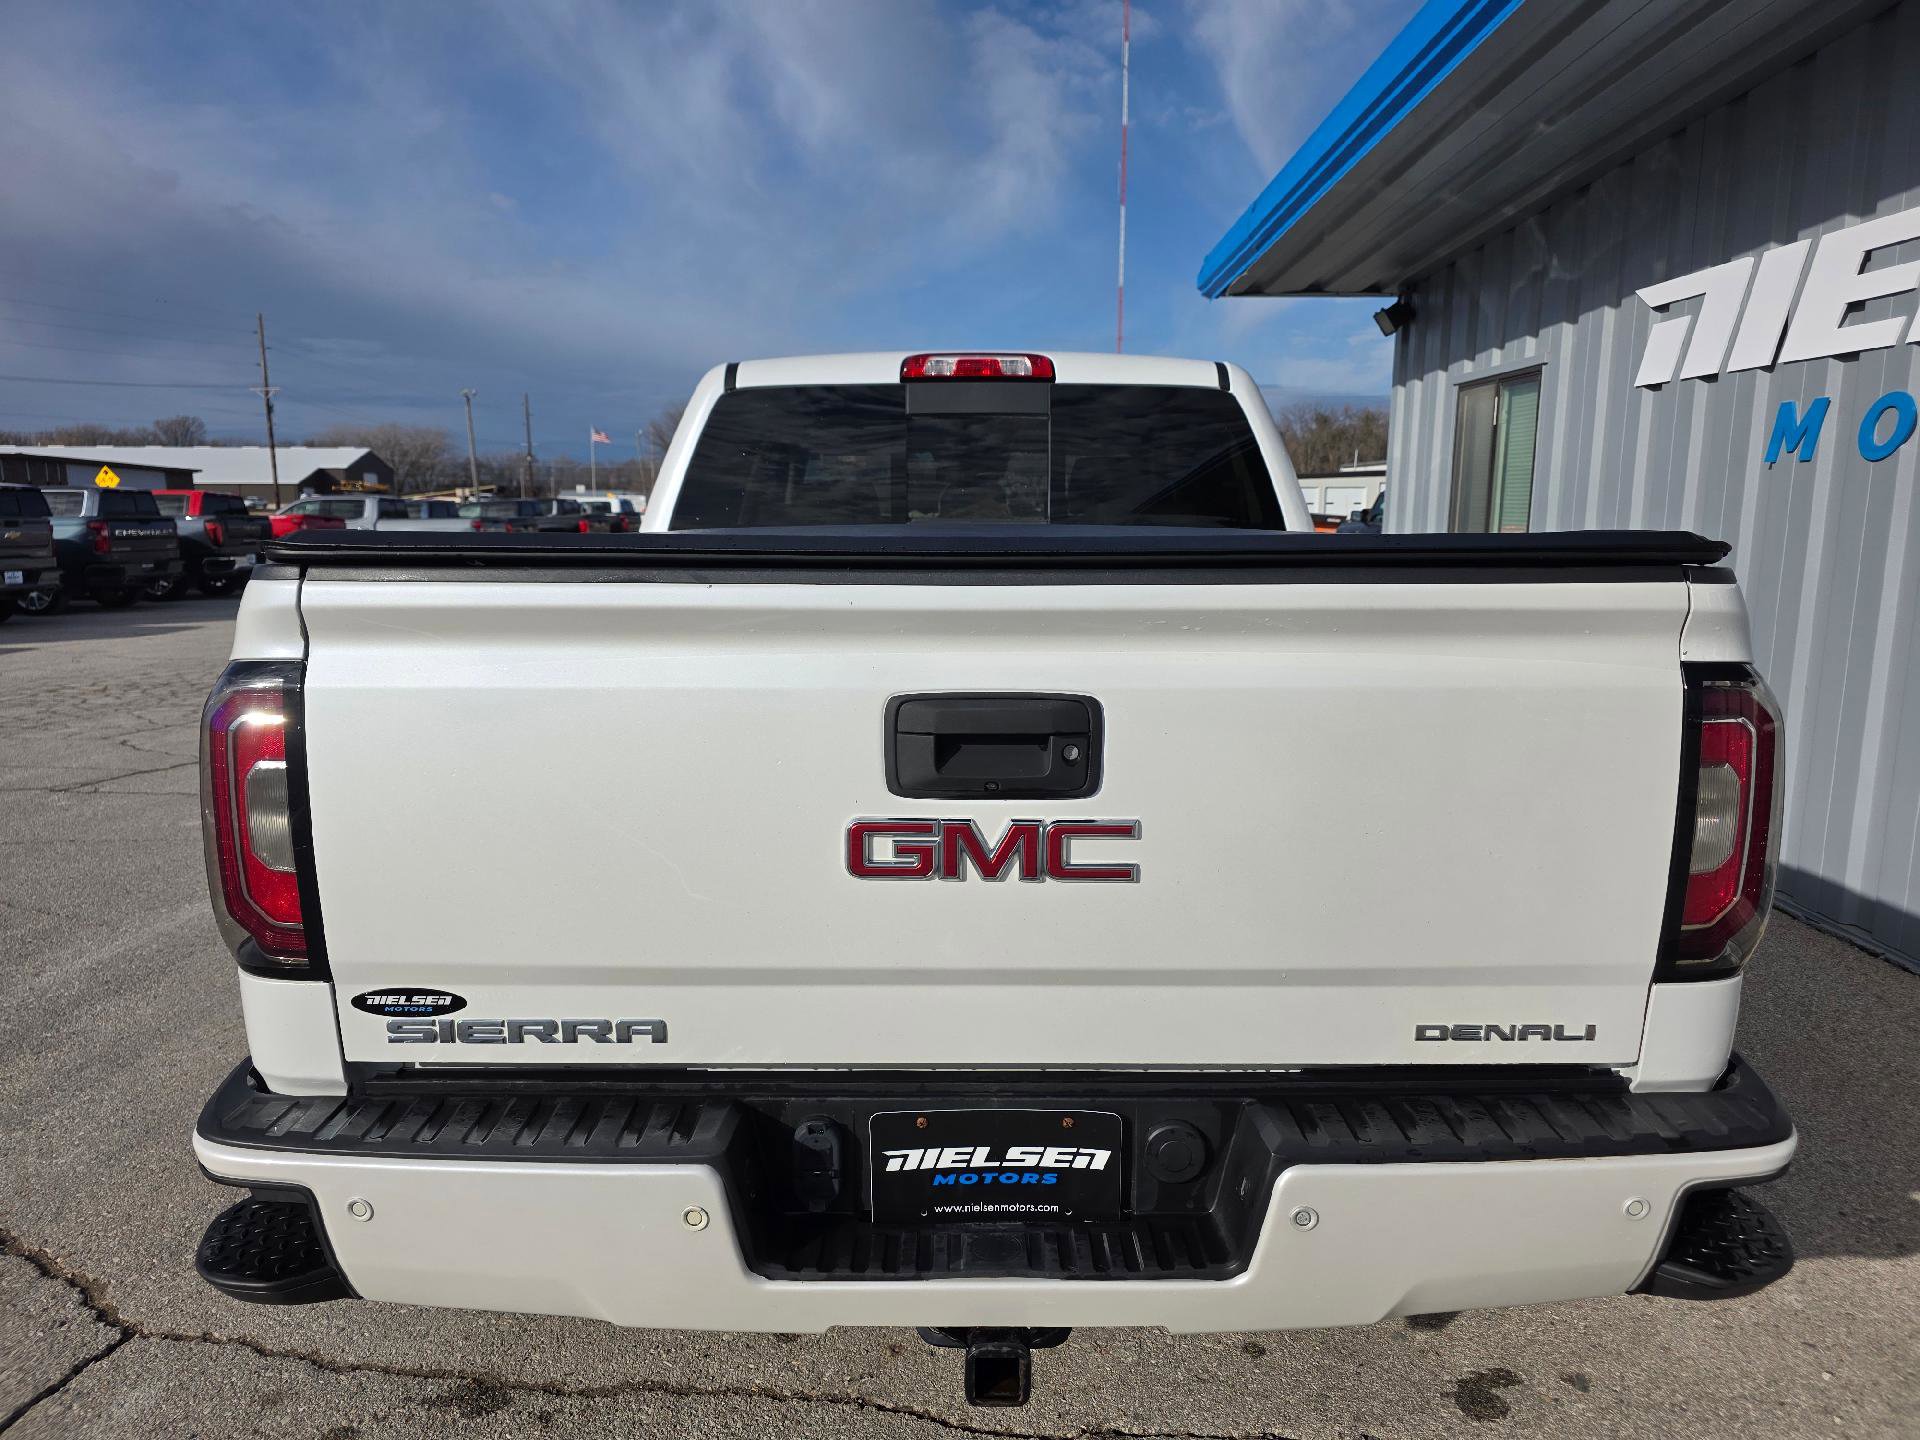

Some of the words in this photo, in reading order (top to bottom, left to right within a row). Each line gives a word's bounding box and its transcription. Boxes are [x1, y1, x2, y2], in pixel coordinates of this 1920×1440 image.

[1634, 206, 1920, 388] NIE
[845, 816, 1142, 883] GMC
[364, 995, 453, 1006] NIELSEN
[386, 1018, 668, 1044] SIERRA
[1414, 1024, 1597, 1042] DENALI
[881, 1146, 1112, 1172] NIELSEN
[932, 1172, 1058, 1186] MOTORS
[934, 1201, 1059, 1214] www.nielsenmotors.com
